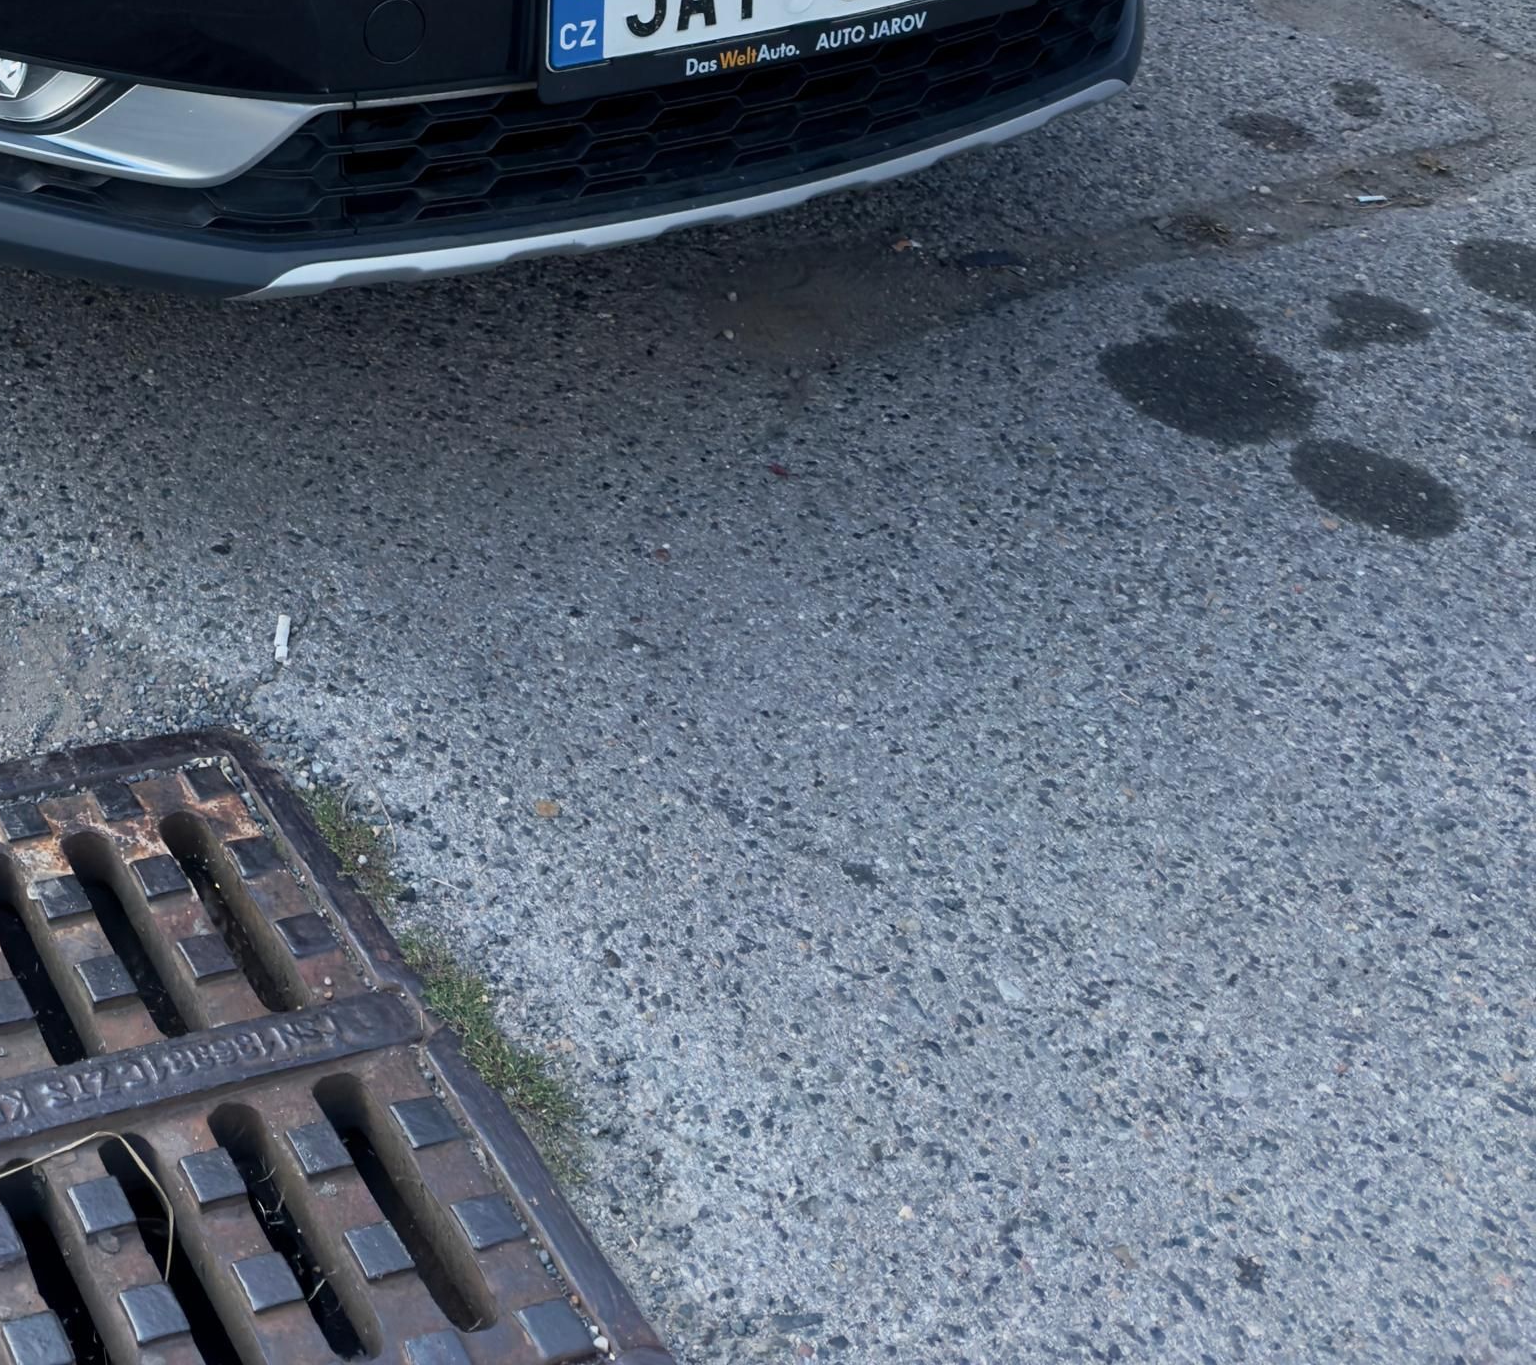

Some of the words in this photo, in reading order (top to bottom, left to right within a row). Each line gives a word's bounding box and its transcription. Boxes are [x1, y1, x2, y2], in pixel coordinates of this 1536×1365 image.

[559, 19, 597, 51] CZ
[685, 57, 717, 76] Das
[815, 25, 866, 51] AUTO
[868, 11, 927, 40] JAROV
